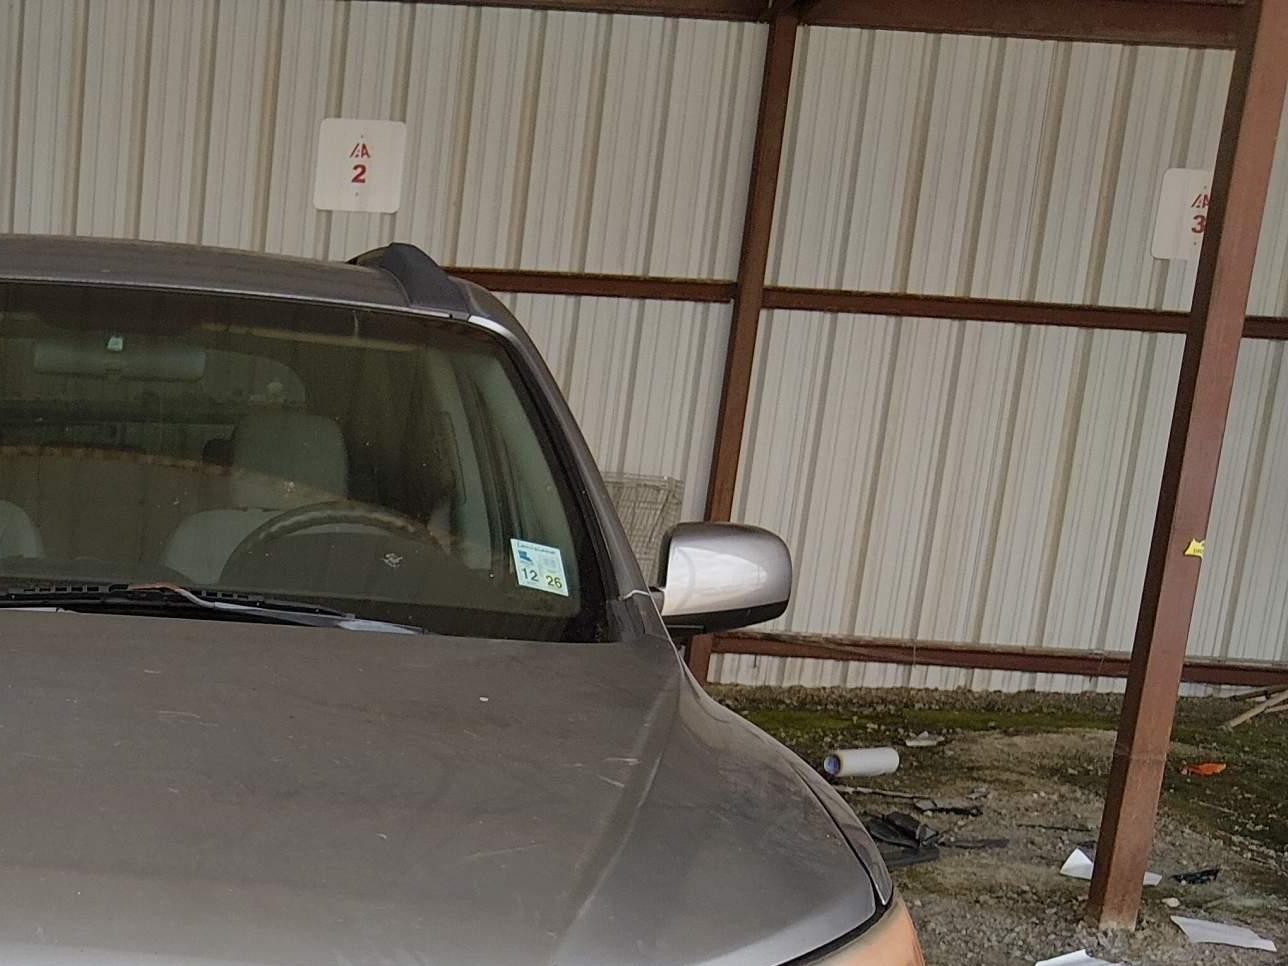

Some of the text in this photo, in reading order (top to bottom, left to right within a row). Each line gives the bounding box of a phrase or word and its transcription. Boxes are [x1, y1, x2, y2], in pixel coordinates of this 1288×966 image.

[351, 163, 367, 184] 2
[1191, 214, 1206, 234] 3
[521, 567, 563, 589] 12 26
